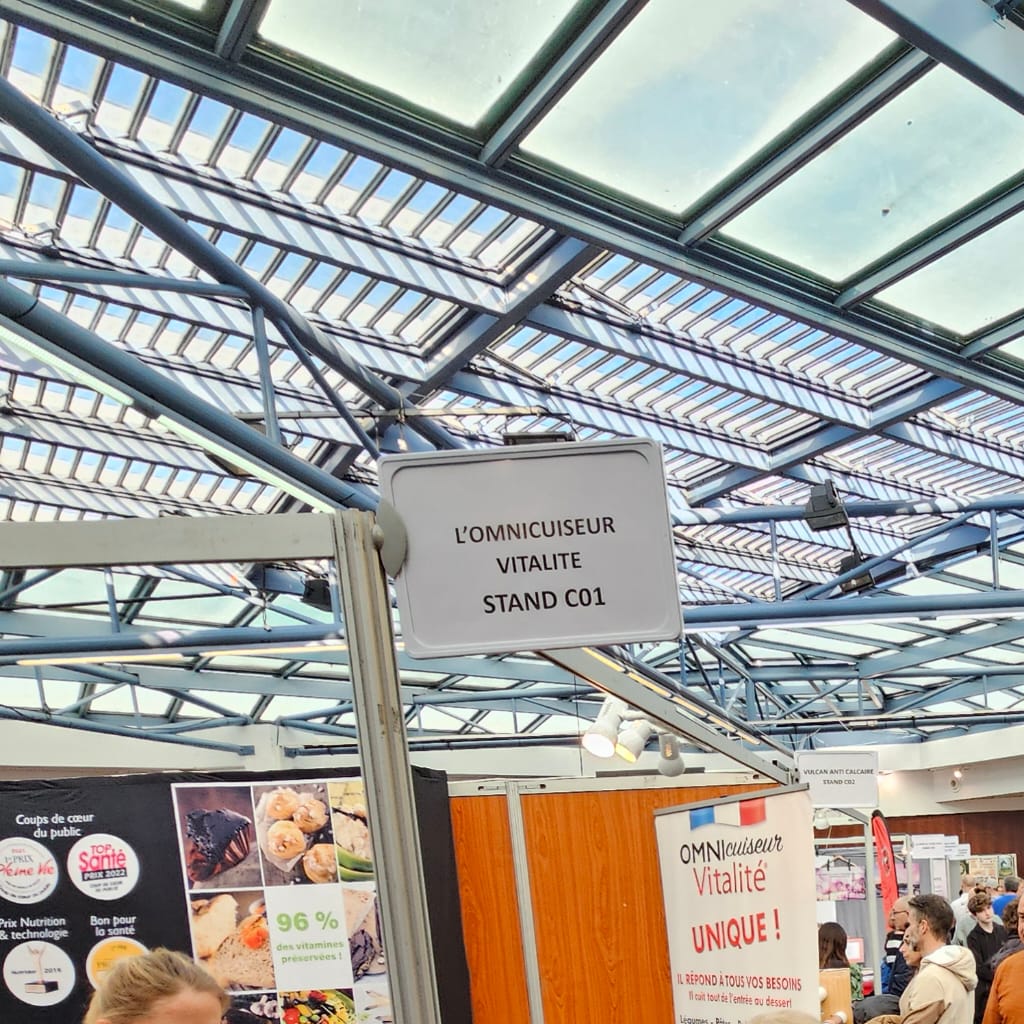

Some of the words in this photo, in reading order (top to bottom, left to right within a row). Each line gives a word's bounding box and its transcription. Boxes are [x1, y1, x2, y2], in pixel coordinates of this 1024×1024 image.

[496, 551, 582, 574] VITALITE
[482, 590, 557, 614] STAND
[564, 586, 606, 609] C01
[16, 814, 49, 827] Coups
[51, 813, 65, 824] de
[67, 814, 94, 823] cœur
[33, 827, 47, 838] du
[50, 826, 82, 840] public
[91, 844, 112, 854] TOP
[680, 834, 783, 864] OMNIcuiseur
[79, 849, 126, 872] Santé
[84, 872, 104, 880] PRIX
[693, 860, 766, 896] Vitalité
[20, 917, 66, 927] Nutrition
[90, 916, 110, 926] Bon
[113, 915, 136, 928] pour
[276, 912, 309, 932] 96
[315, 911, 339, 930] %
[0, 931, 8, 940] &
[11, 928, 68, 940] technologie
[96, 927, 105, 936] la
[107, 926, 136, 936] santé
[692, 912, 767, 954] UNIQUE
[773, 908, 780, 940] !
[296, 941, 344, 950] vitamines
[282, 953, 336, 964] préservées
[677, 974, 683, 985] IL
[685, 971, 717, 986] RÉPOND
[725, 975, 745, 988] TOUS
[746, 976, 763, 989] VOS
[766, 977, 802, 991] BESOINS
[695, 991, 706, 1001] cuit
[707, 993, 720, 1002] tout
[721, 994, 728, 1003] de
[755, 998, 763, 1006] au
[766, 996, 792, 1008] dessert
